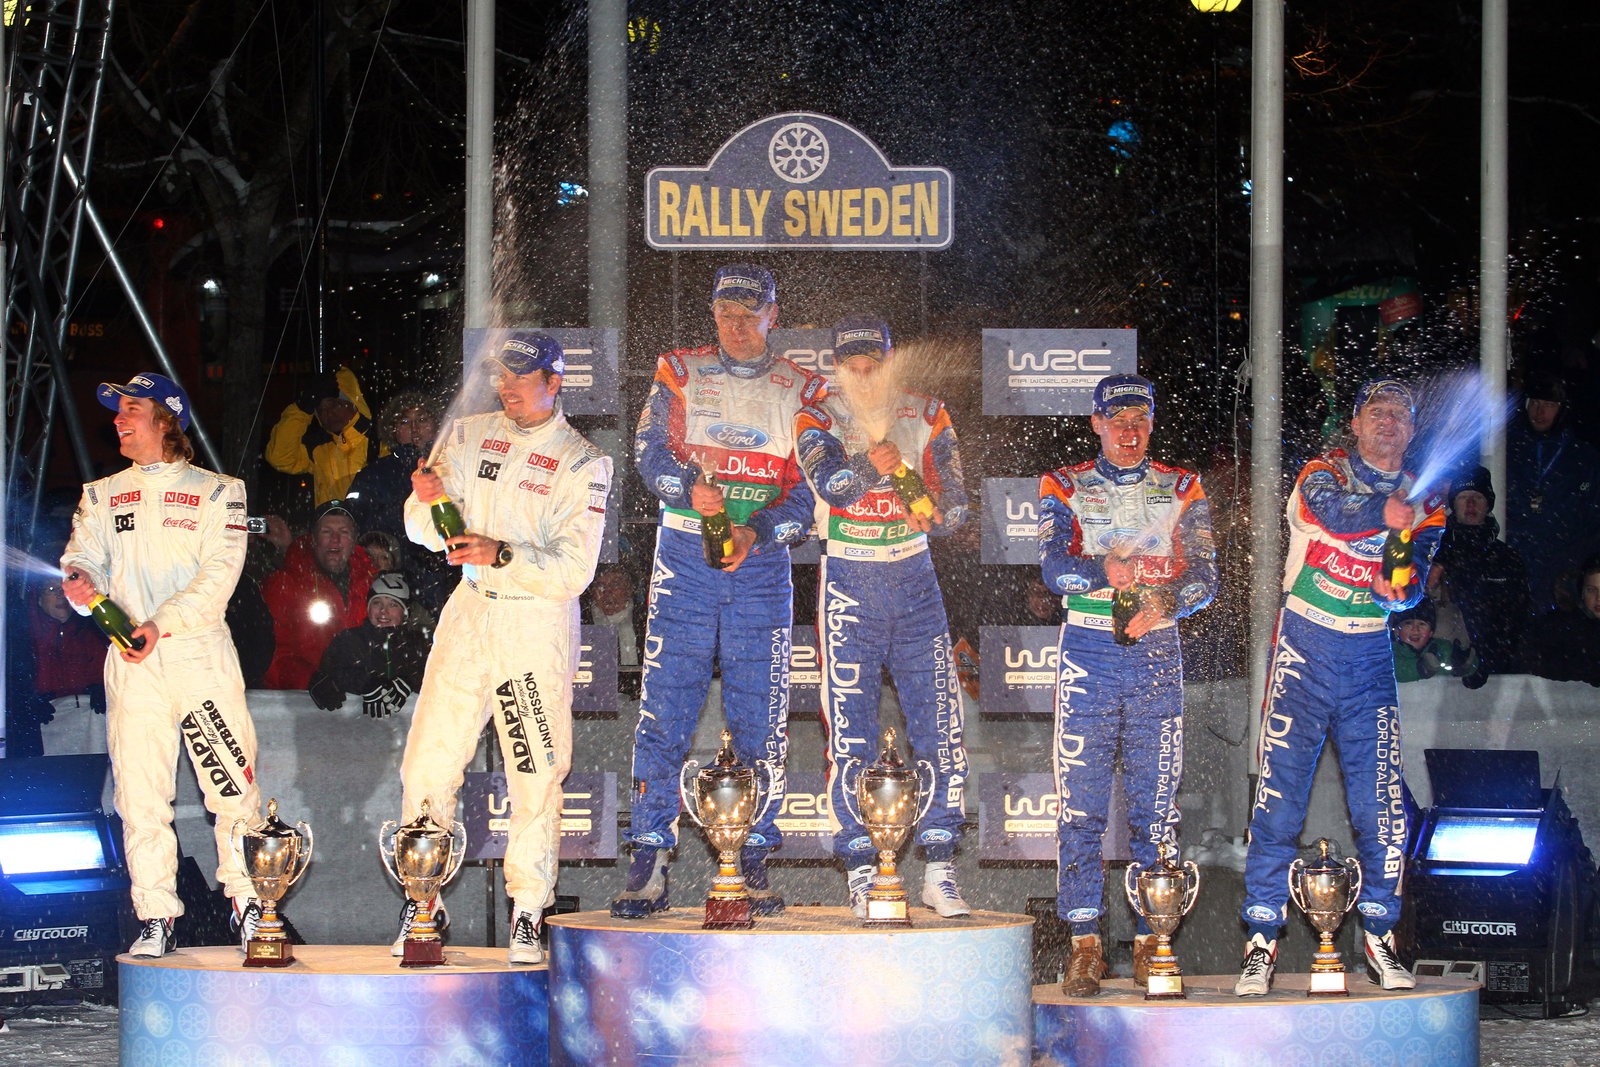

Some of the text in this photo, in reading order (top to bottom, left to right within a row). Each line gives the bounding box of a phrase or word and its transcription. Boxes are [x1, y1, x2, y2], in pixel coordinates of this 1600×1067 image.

[659, 180, 939, 237] RALLY SWEDEN
[1008, 349, 1112, 371] WRC
[717, 426, 757, 447] Ford
[528, 453, 560, 472] NDS
[111, 490, 141, 507] NDS
[165, 492, 200, 506] NDS
[849, 526, 880, 538] Castrol
[1320, 552, 1352, 580] Abu
[1319, 580, 1350, 599] Castrol
[768, 628, 781, 683] WORLD
[780, 628, 790, 689] FORD
[827, 582, 867, 763] Abu Dhabi
[933, 635, 950, 774] WORLD RALLY TEAM
[1059, 651, 1088, 718] Abu
[496, 680, 534, 774] ADAPTA
[523, 672, 554, 749] ANDERSSON
[768, 686, 779, 729] RALLY
[775, 692, 787, 738] ABU
[949, 698, 961, 744] ABU
[1255, 636, 1306, 813] Abu Dhabi
[181, 713, 240, 797] ADAPTA
[1159, 719, 1171, 772] WORLD
[1171, 716, 1182, 777] FORD
[1389, 705, 1401, 766] FORD
[1154, 774, 1169, 818] RALLY
[1376, 705, 1390, 846] WORLD RALLY TEAM
[1388, 769, 1402, 815] ABU
[637, 832, 659, 844] Ford
[925, 830, 948, 842] Ford
[1072, 909, 1094, 921] Ford
[1250, 907, 1275, 920] Ford
[1361, 902, 1387, 916] Ford
[1443, 920, 1517, 936] City COLOR
[13, 927, 88, 941] City COLOR
